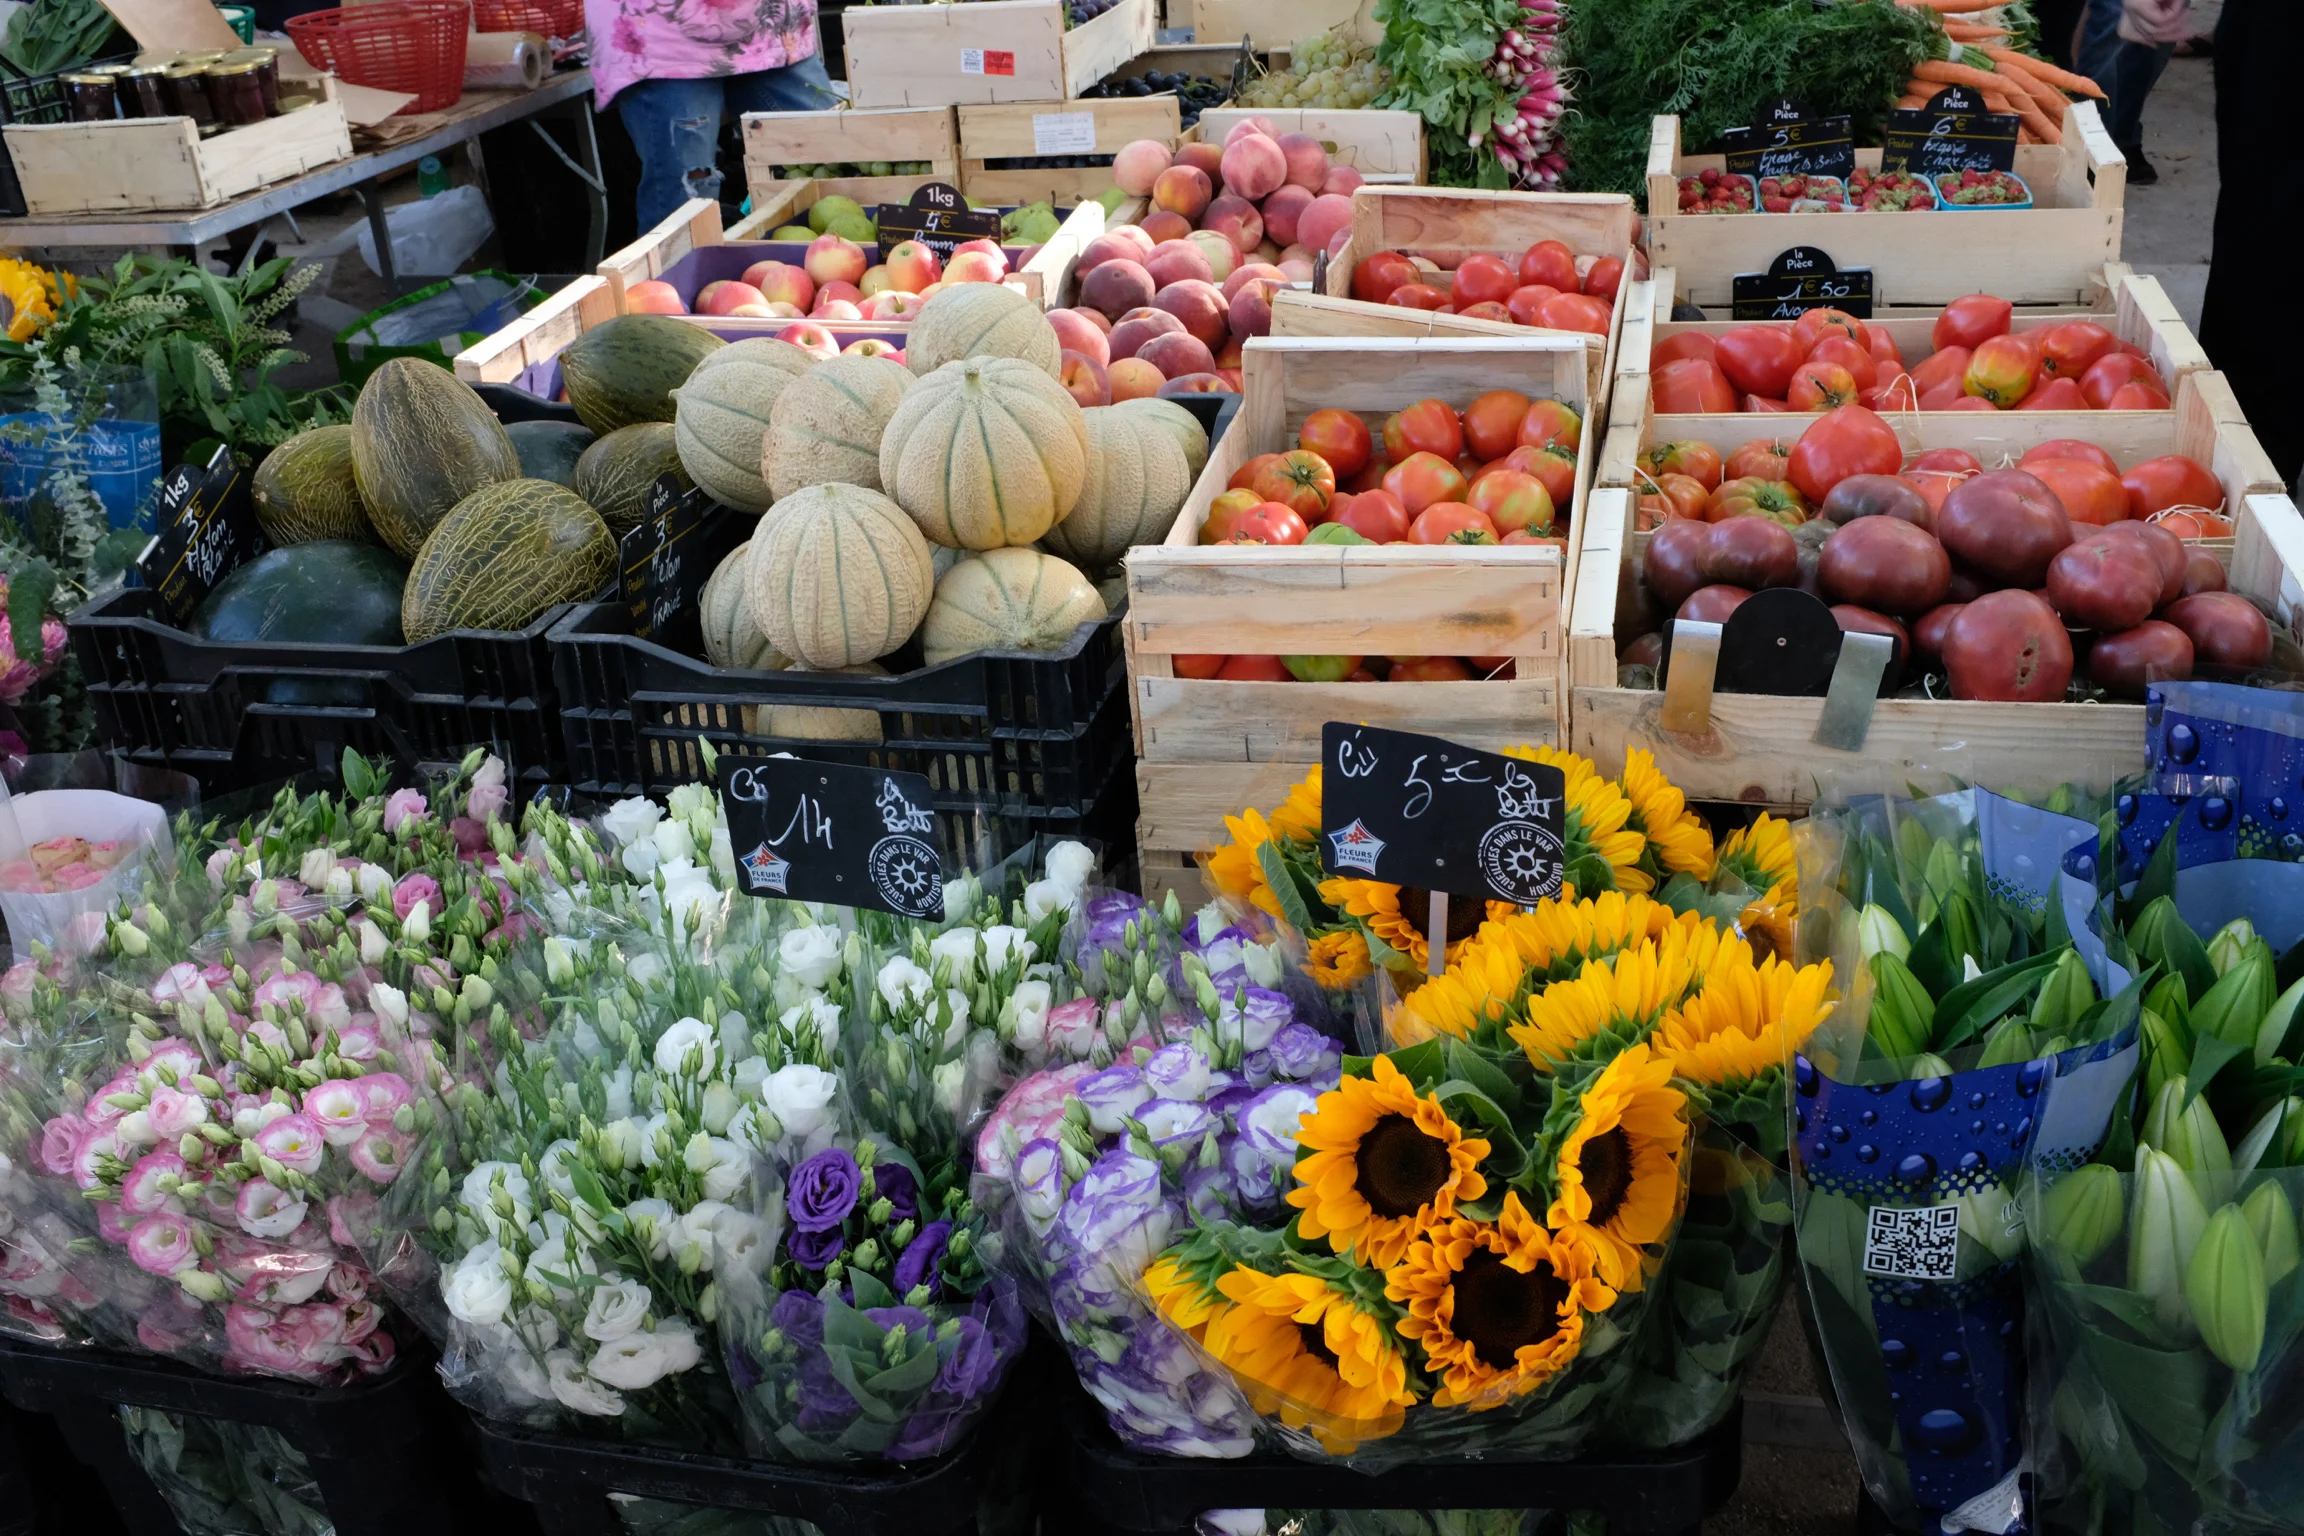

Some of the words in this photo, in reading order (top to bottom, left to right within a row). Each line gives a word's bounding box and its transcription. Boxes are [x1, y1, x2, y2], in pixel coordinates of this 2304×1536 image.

[1953, 88, 1961, 99] la
[1782, 100, 1790, 110] la
[1943, 98, 1968, 108] Pièce
[1774, 109, 1799, 120] Pièce
[1929, 116, 1952, 136] 6
[1770, 130, 1788, 148] 5
[926, 186, 954, 208] 1kg
[1794, 249, 1803, 259] la
[1786, 259, 1813, 270] Pièce
[1820, 281, 1850, 297] 50
[164, 473, 190, 508] 1kg
[653, 490, 670, 514] Pièce
[182, 506, 199, 544] 3
[1403, 754, 1433, 819] 5
[1494, 829, 1518, 848] DANS
[1520, 830, 1532, 842] LE
[1535, 834, 1554, 852] VAR
[880, 844, 900, 862] DANS
[900, 844, 911, 854] LE
[914, 847, 930, 864] VAR
[1339, 848, 1372, 858] FLEURS
[1348, 856, 1372, 864] FRANCE
[1488, 846, 1516, 890] CUEILLIES
[752, 870, 782, 878] FLEURS
[877, 862, 904, 904] CUEILLIES
[1528, 862, 1564, 896] HORTISUD
[916, 874, 941, 908] HORTISUD
